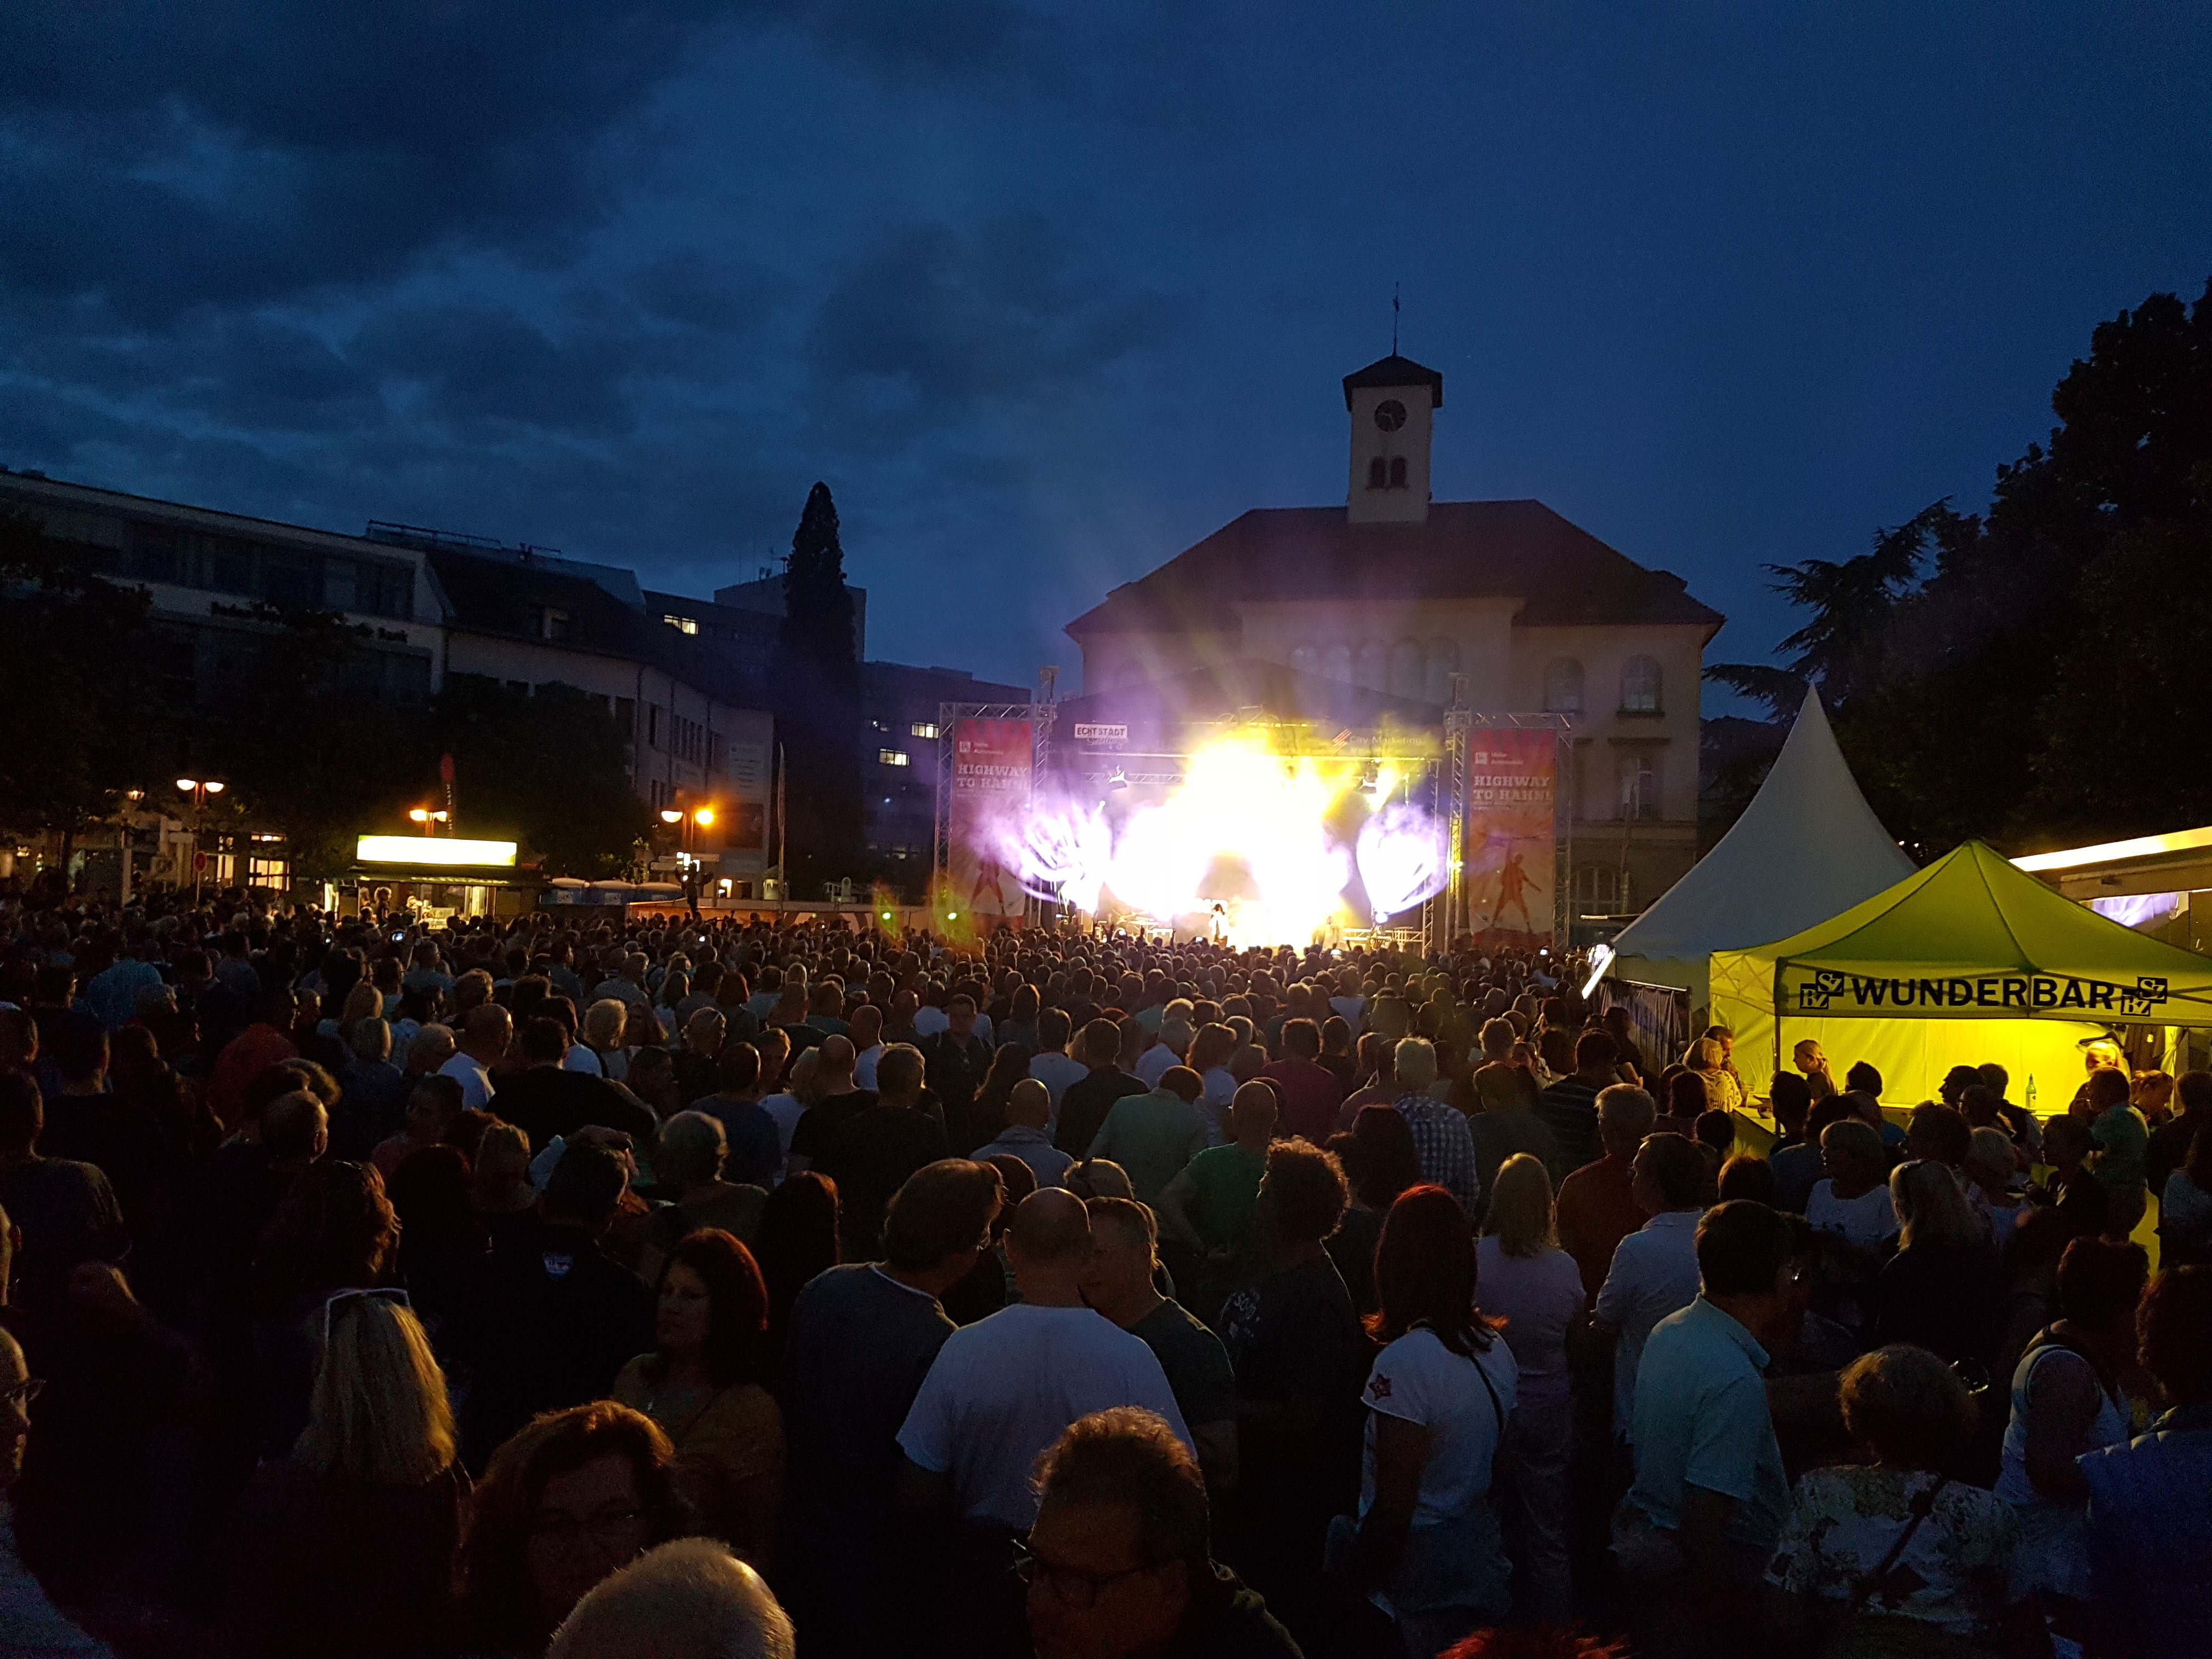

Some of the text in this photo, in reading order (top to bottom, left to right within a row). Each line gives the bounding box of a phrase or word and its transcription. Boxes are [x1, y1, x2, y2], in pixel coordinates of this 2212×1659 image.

[1077, 727, 1125, 736] ECHT STADT
[1350, 736, 1422, 746] City Marketing
[957, 763, 1029, 777] HIGHWAY
[957, 777, 975, 787] TO
[1474, 775, 1551, 787] HIGHWAY
[1473, 789, 1550, 800] TO HAHN!
[1852, 978, 2113, 1009] WUNDERBAR
